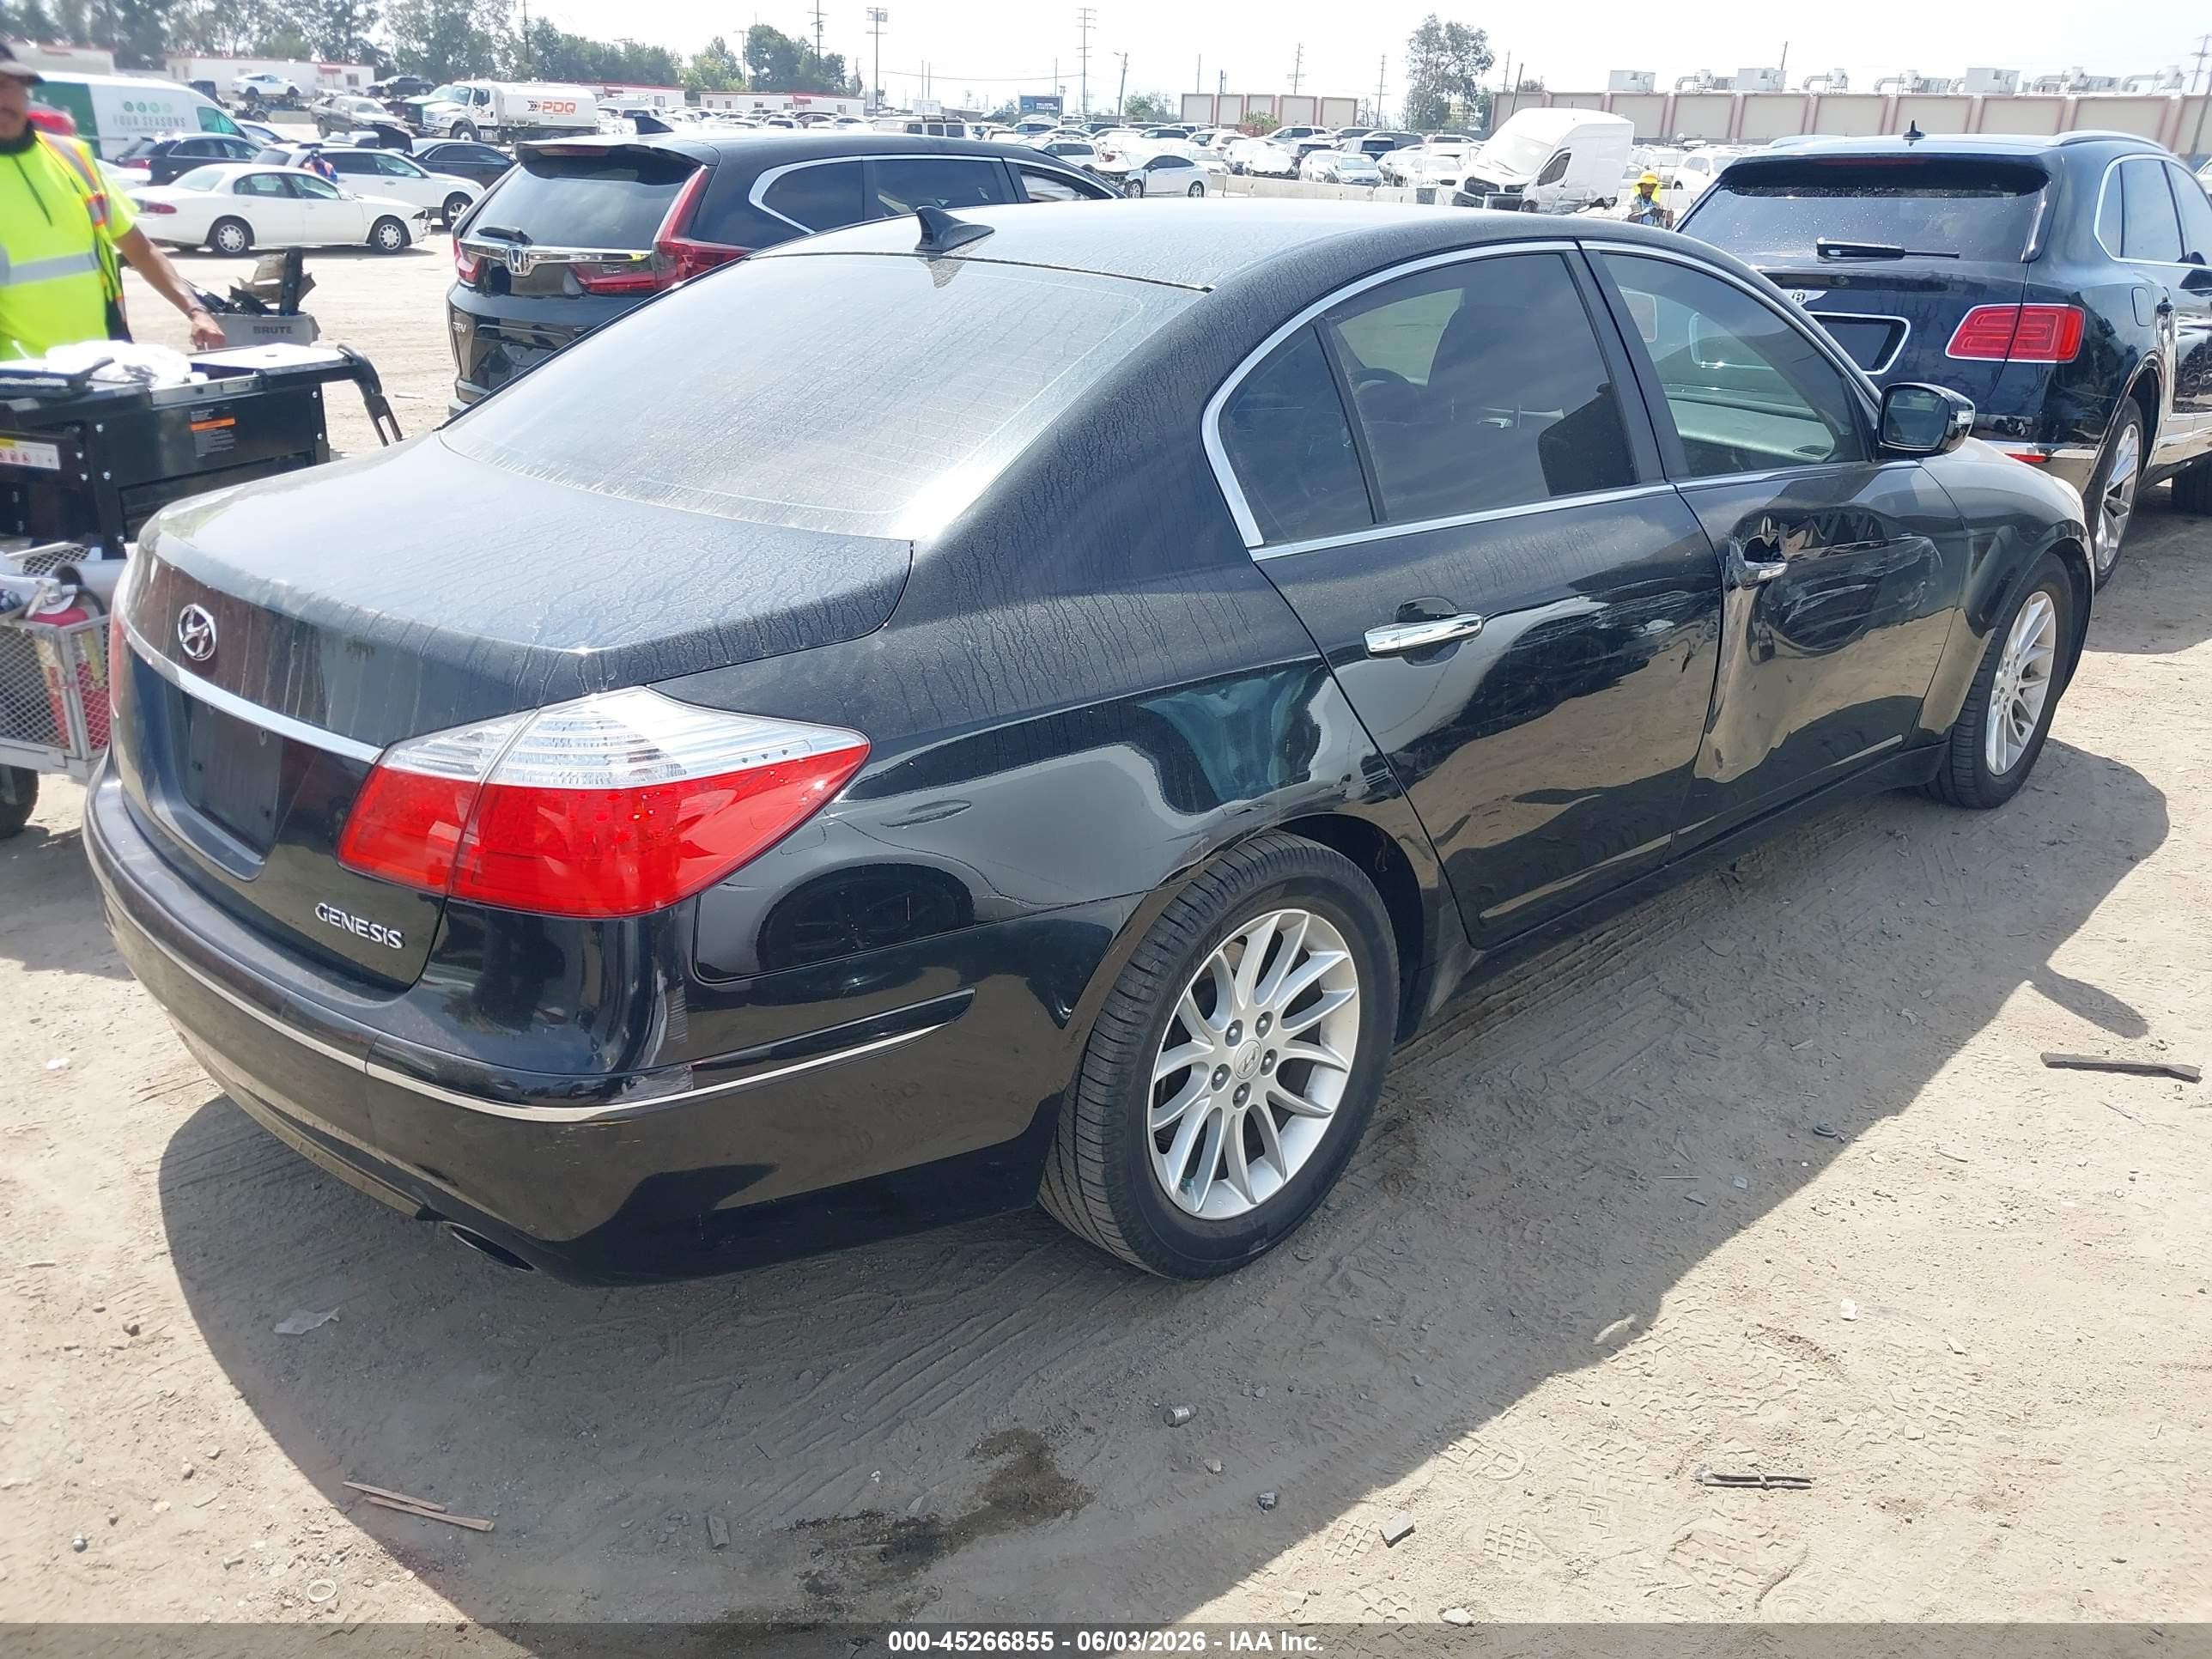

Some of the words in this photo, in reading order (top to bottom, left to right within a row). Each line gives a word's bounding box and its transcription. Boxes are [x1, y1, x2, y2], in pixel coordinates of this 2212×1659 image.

[543, 101, 576, 114] PDQ
[143, 116, 186, 128] SEASONS
[253, 325, 293, 334] BRUTE
[314, 902, 404, 949] GENESIS
